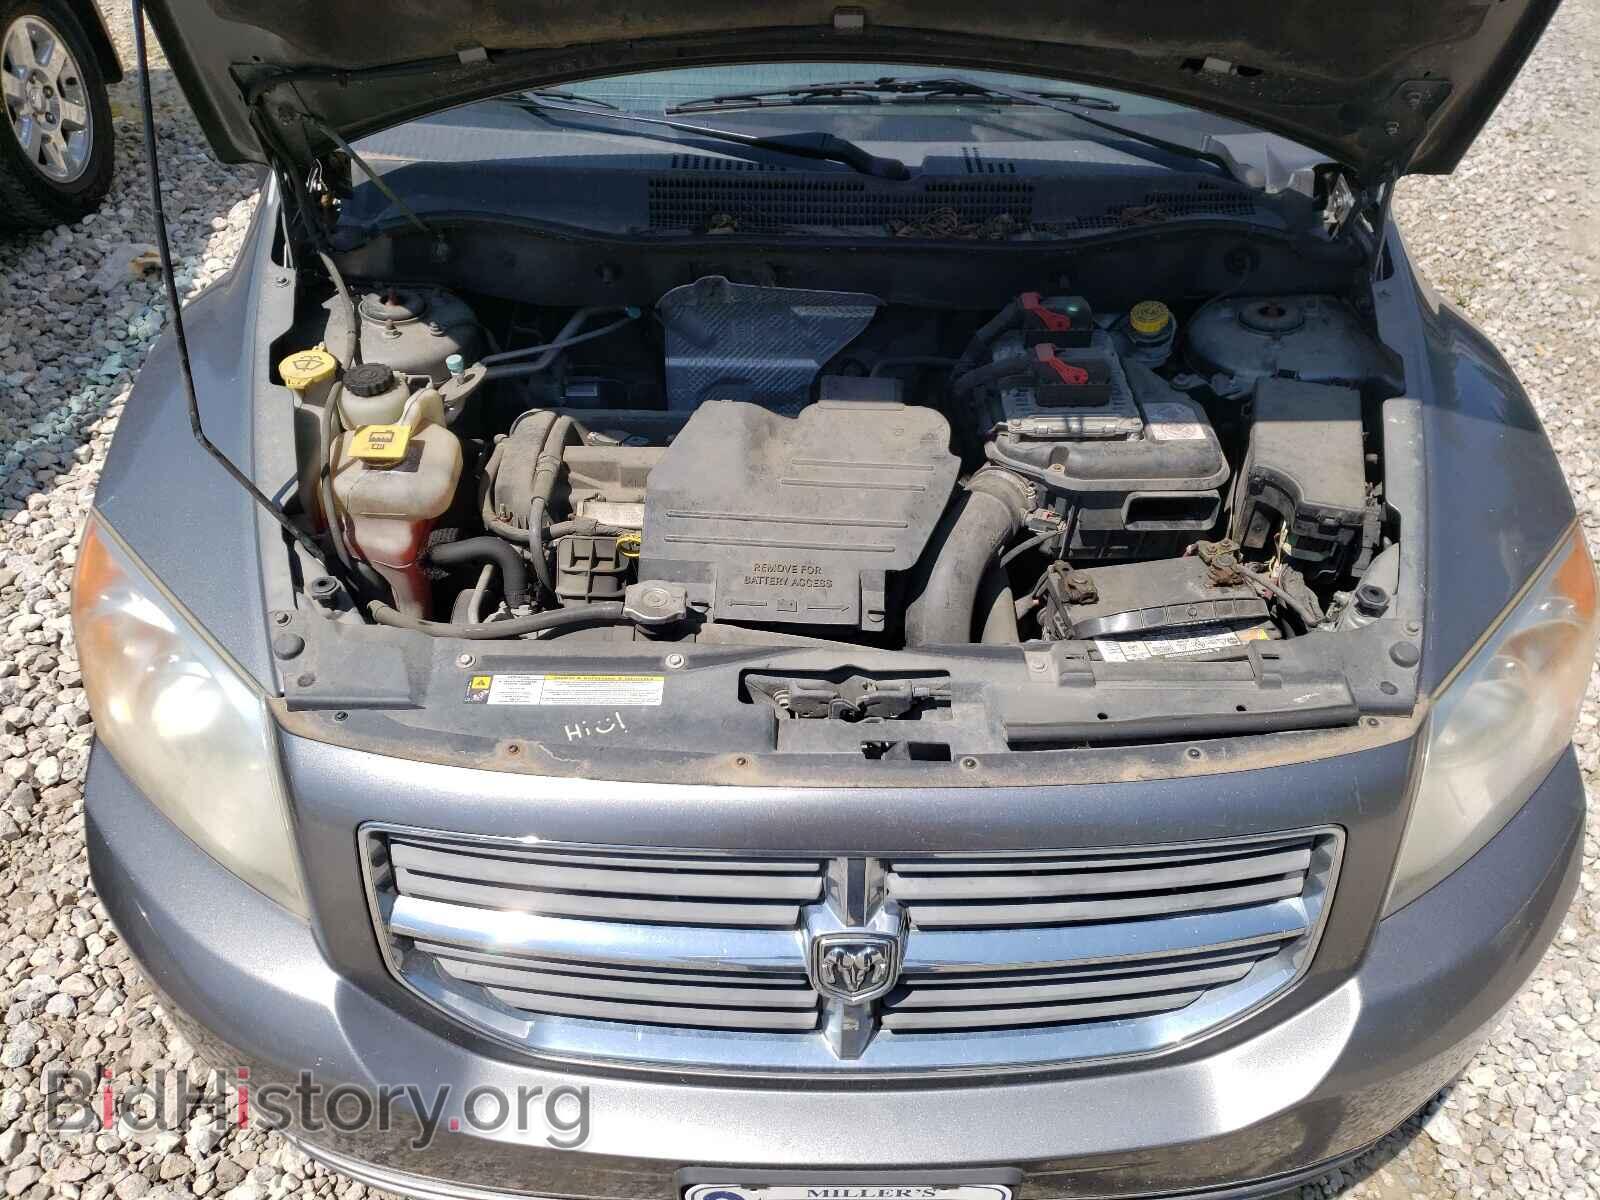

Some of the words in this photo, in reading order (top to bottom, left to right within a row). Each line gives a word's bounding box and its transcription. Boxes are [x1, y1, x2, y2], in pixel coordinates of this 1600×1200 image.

[753, 563, 798, 574] REMOVE
[800, 565, 822, 575] FOR
[744, 576, 789, 586] BATTERY
[791, 577, 833, 588] ACCESS
[807, 1188, 937, 1198] MILLER'S
